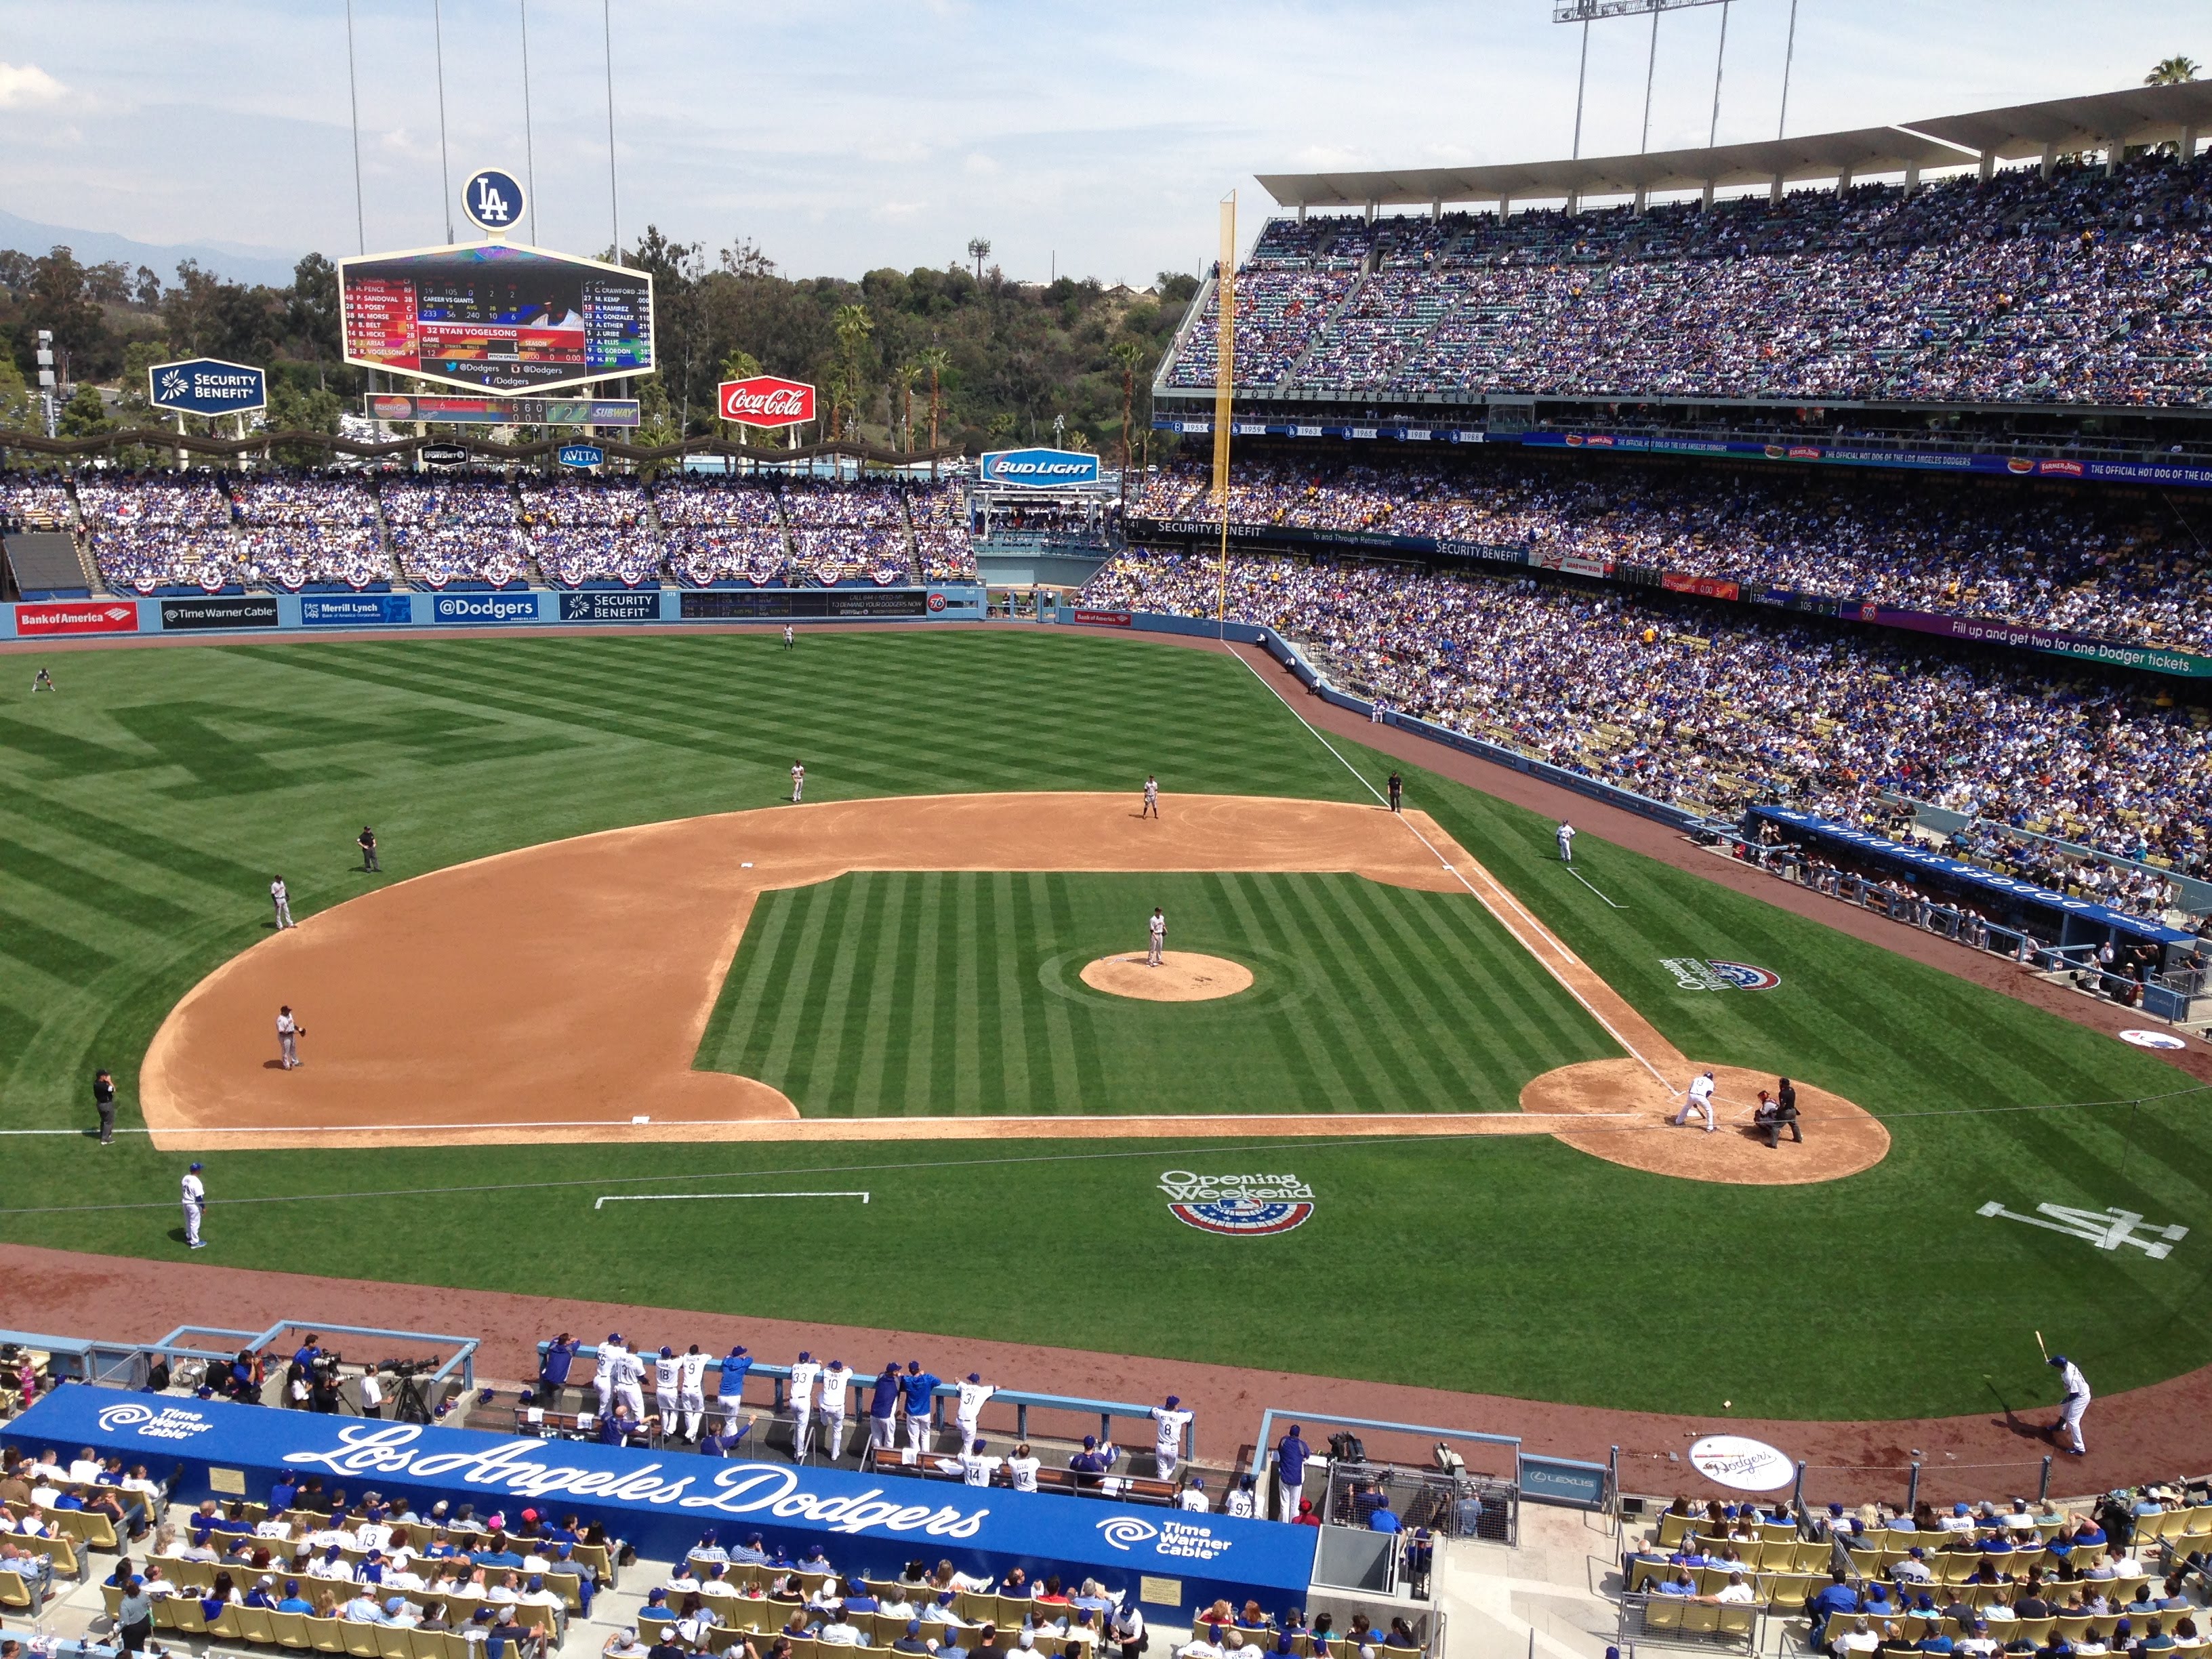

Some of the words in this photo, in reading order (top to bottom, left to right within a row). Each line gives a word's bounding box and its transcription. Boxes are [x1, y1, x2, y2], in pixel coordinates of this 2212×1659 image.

[477, 178, 508, 220] LA
[465, 329, 517, 337] VOGELSONG
[459, 363, 499, 373] @Dodgers
[523, 365, 562, 375] @Dodgers
[194, 373, 256, 386] SECURITY
[493, 377, 529, 386] /Dodgers
[194, 386, 248, 399] BENEFIT
[1236, 390, 1318, 401] DODGER
[1334, 391, 1425, 403] STADIUM
[1441, 394, 1487, 404] CLUB
[727, 388, 806, 415] Coca-Cola
[593, 408, 636, 418] SUBWAY
[1357, 429, 1372, 437] 1965
[1464, 432, 1479, 441] 1988
[563, 450, 599, 462] AVITA
[1917, 455, 1942, 464] ANGELES
[1942, 456, 1971, 466] DODGERS
[995, 462, 1036, 474] BUD
[1036, 462, 1092, 474] LIGHT
[2042, 463, 2064, 471] FARMER
[2091, 464, 2104, 474] THE
[2106, 466, 2136, 476] OFFICIAL
[2138, 468, 2153, 476] HOT
[2154, 468, 2170, 478] DOG
[2173, 470, 2182, 478] OF
[2185, 470, 2198, 480] THE
[1158, 521, 1212, 534] SECURITY
[1313, 532, 1320, 540] To
[1335, 534, 1359, 545] Through
[1360, 535, 1391, 546] Retirement
[1436, 541, 1481, 558] SECURITY
[1482, 546, 1518, 562] BENEFIT
[1663, 579, 1671, 588] 32
[1700, 584, 1713, 594] 0.00
[594, 594, 652, 606] SECURITY
[929, 596, 943, 609] 76
[1753, 594, 1761, 602] 13
[1761, 595, 1784, 607] Ramirez
[178, 609, 204, 619] Time
[205, 608, 243, 618] Warner
[245, 607, 273, 617] Cable
[321, 603, 350, 612] Merrill
[352, 603, 377, 613] Lynch
[440, 598, 533, 619] @Dodgers
[594, 607, 644, 618] BENEFIT
[1863, 606, 1875, 621] 76
[22, 615, 49, 626] Bank
[49, 613, 60, 624] of
[61, 613, 104, 624] America
[1952, 621, 1967, 634] Fill
[1969, 626, 1983, 638] up
[1986, 629, 2007, 641] and
[2009, 632, 2028, 646] get
[2031, 634, 2051, 649] two
[2055, 638, 2070, 651] for
[2073, 642, 2096, 655] one
[2099, 645, 2145, 665] Dodger
[1818, 824, 1946, 863] STADIUM
[1951, 865, 2091, 909] DODGER
[1658, 958, 1706, 990] Opening
[1160, 1170, 1302, 1189] Opening
[1156, 1184, 1315, 1200] Weekend
[660, 1369, 670, 1380] 18
[689, 1363, 695, 1375] 9
[793, 1372, 807, 1384] 33
[827, 1379, 838, 1390] 10
[963, 1394, 976, 1406] 31
[160, 1408, 203, 1421] Time
[149, 1416, 213, 1432] Warner
[1164, 1424, 1172, 1435] 8
[138, 1425, 188, 1439] Cable
[282, 1423, 424, 1476] Los
[408, 1438, 696, 1504] Angeles
[680, 1464, 990, 1538] Dodgers
[969, 1468, 980, 1481] 14
[1018, 1471, 1029, 1484] 17
[1548, 1475, 1595, 1488] LEXUS
[1235, 1502, 1251, 1517] 97
[1163, 1521, 1212, 1538] Time
[363, 1533, 377, 1547] 13
[1160, 1532, 1233, 1551] Warner
[1156, 1542, 1213, 1559] Cable
